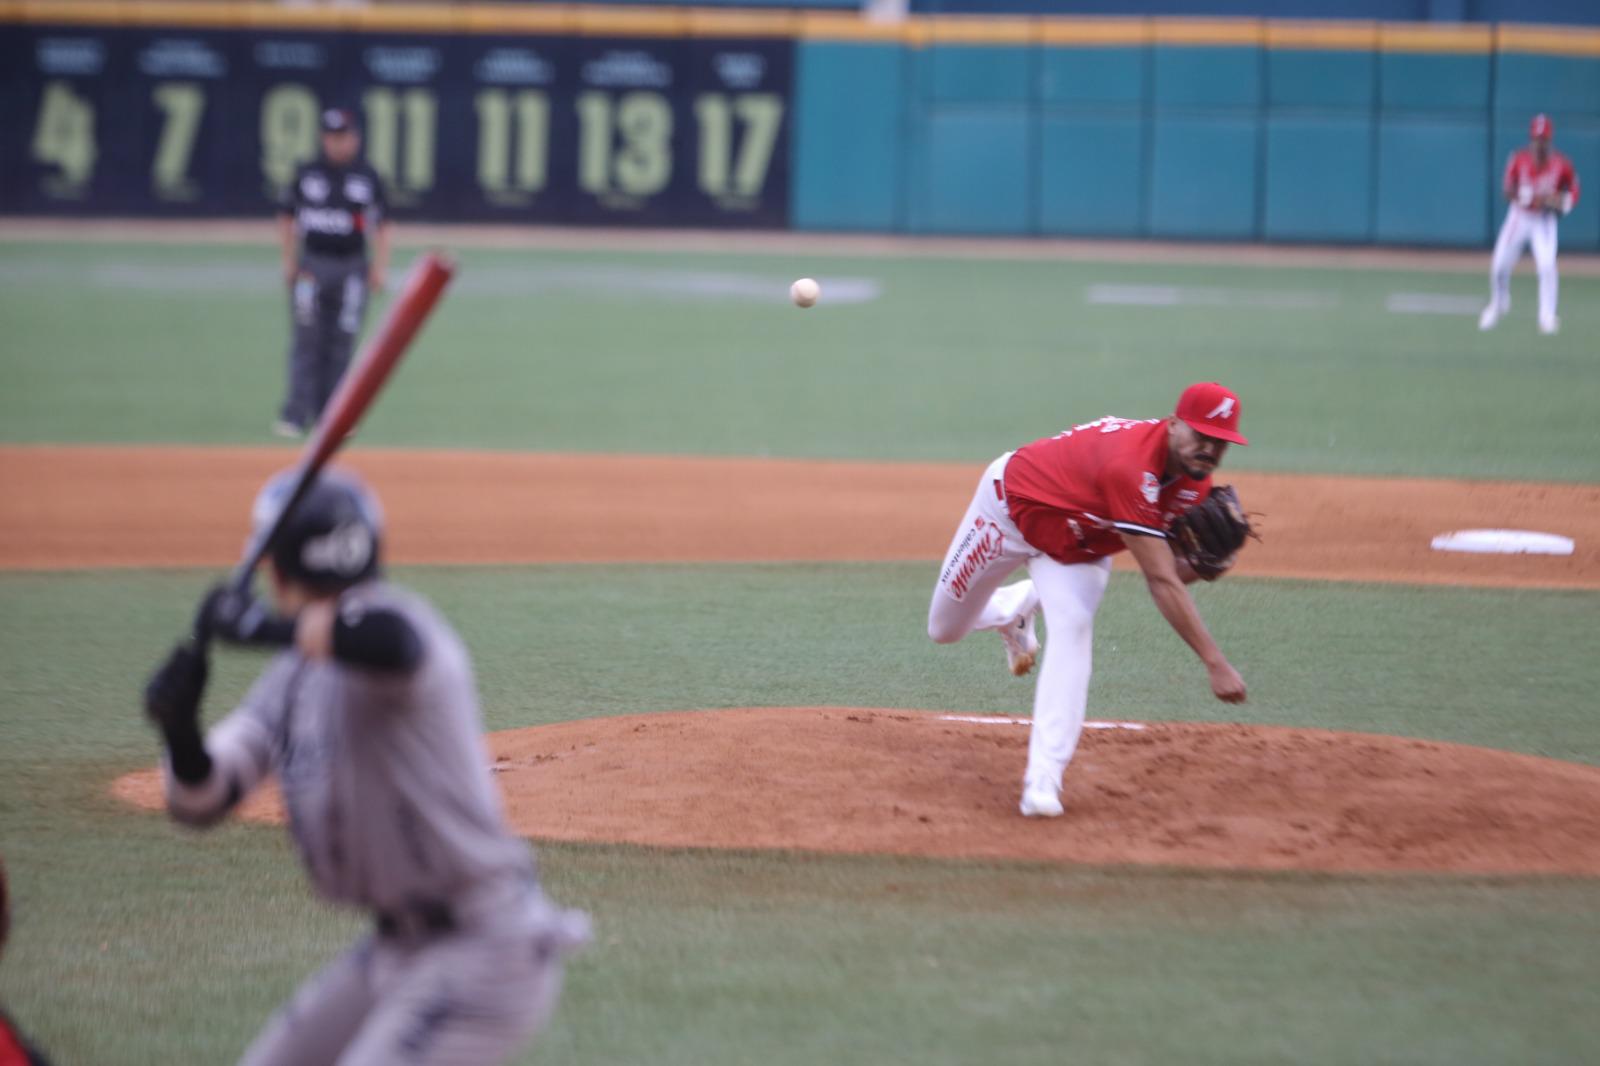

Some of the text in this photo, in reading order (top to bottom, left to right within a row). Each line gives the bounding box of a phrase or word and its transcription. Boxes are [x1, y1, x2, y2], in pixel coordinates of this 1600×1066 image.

[33, 82, 97, 186] 4
[152, 84, 205, 188] 7
[363, 87, 437, 191] 11
[475, 90, 551, 191] 11
[576, 91, 673, 195] 13
[694, 93, 783, 197] 17
